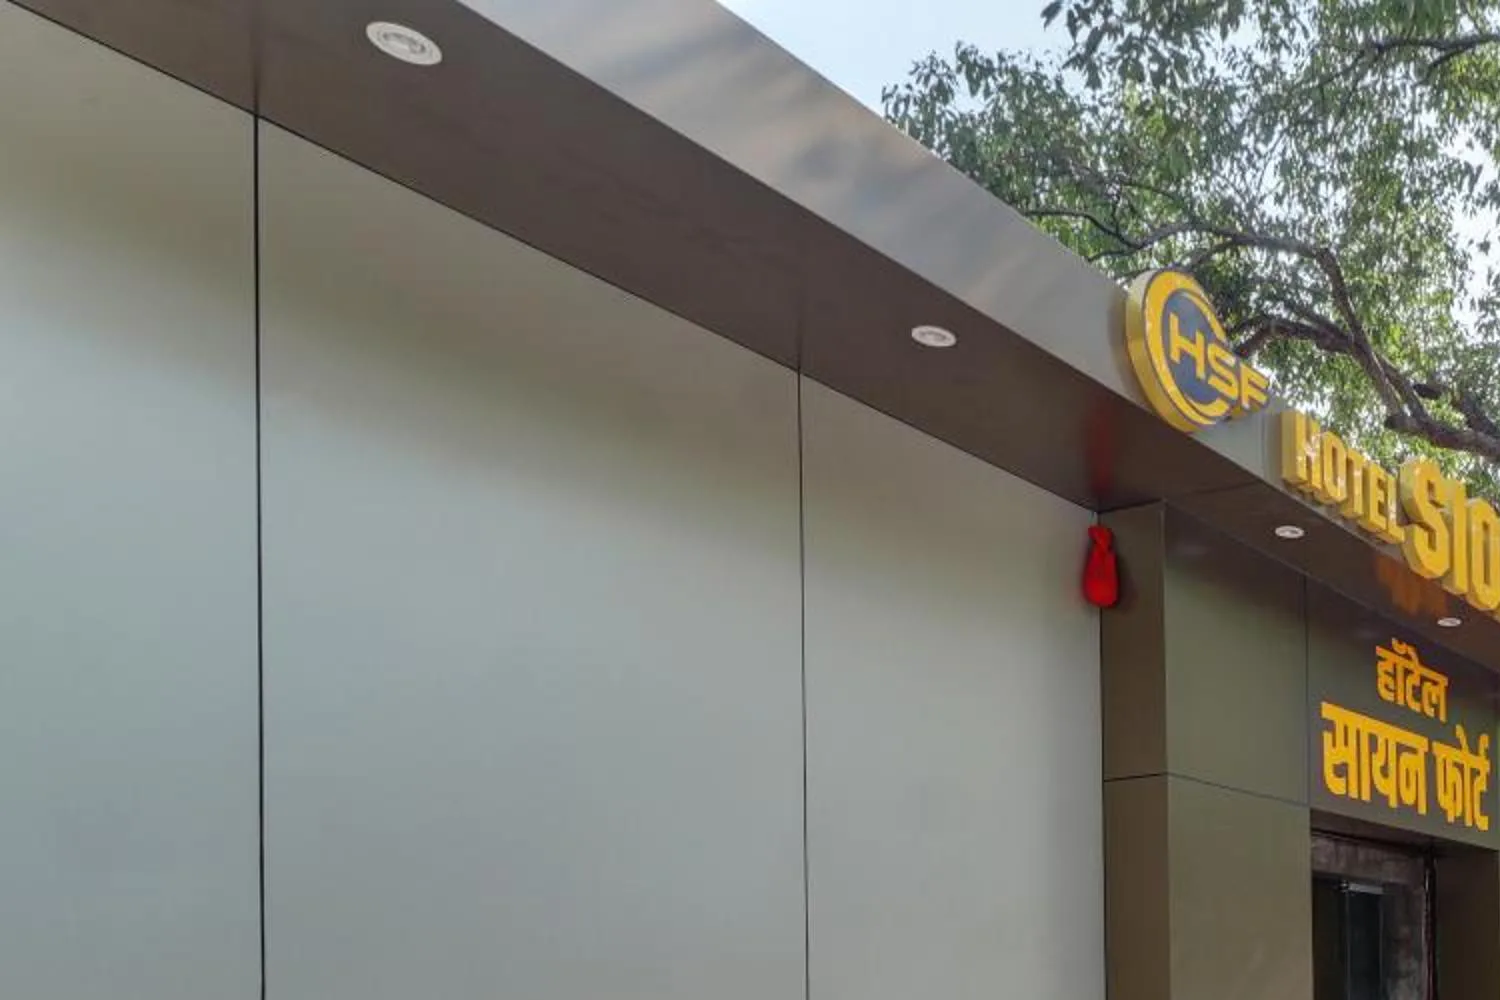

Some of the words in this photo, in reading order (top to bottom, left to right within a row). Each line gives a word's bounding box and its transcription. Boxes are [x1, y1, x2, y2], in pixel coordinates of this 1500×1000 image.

[1169, 311, 1269, 409] HSF
[1283, 410, 1405, 545] HOTEL
[1375, 637, 1449, 723] हॉटेल
[1320, 700, 1429, 815] सायन
[1432, 724, 1490, 832] फोर्ट
